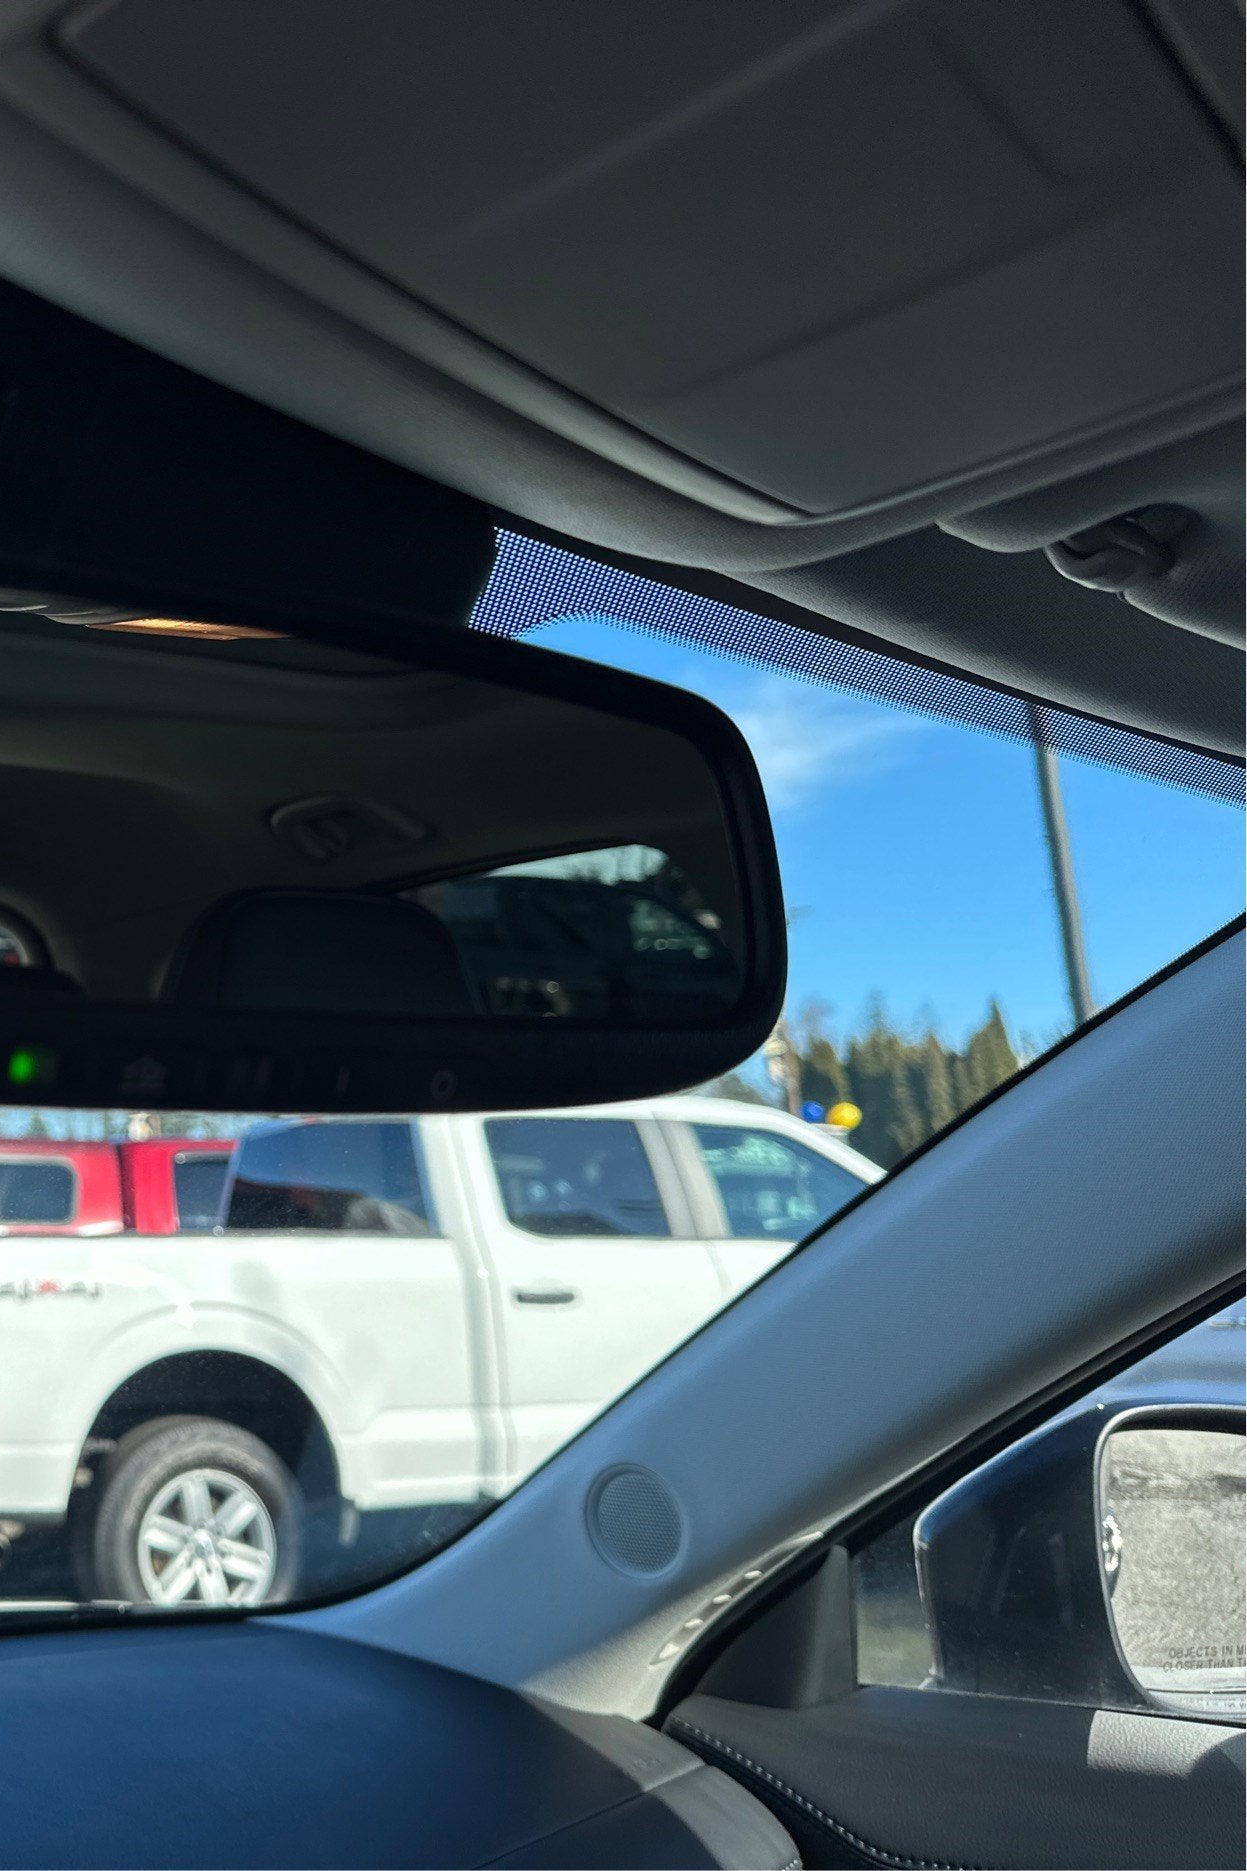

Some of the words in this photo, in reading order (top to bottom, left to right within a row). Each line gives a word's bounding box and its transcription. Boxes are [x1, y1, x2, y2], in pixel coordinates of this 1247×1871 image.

[1168, 1646, 1218, 1659] OBJECTS
[1222, 1645, 1234, 1656] IN
[1163, 1659, 1204, 1673] CLOSER
[1206, 1658, 1234, 1669] THAN
